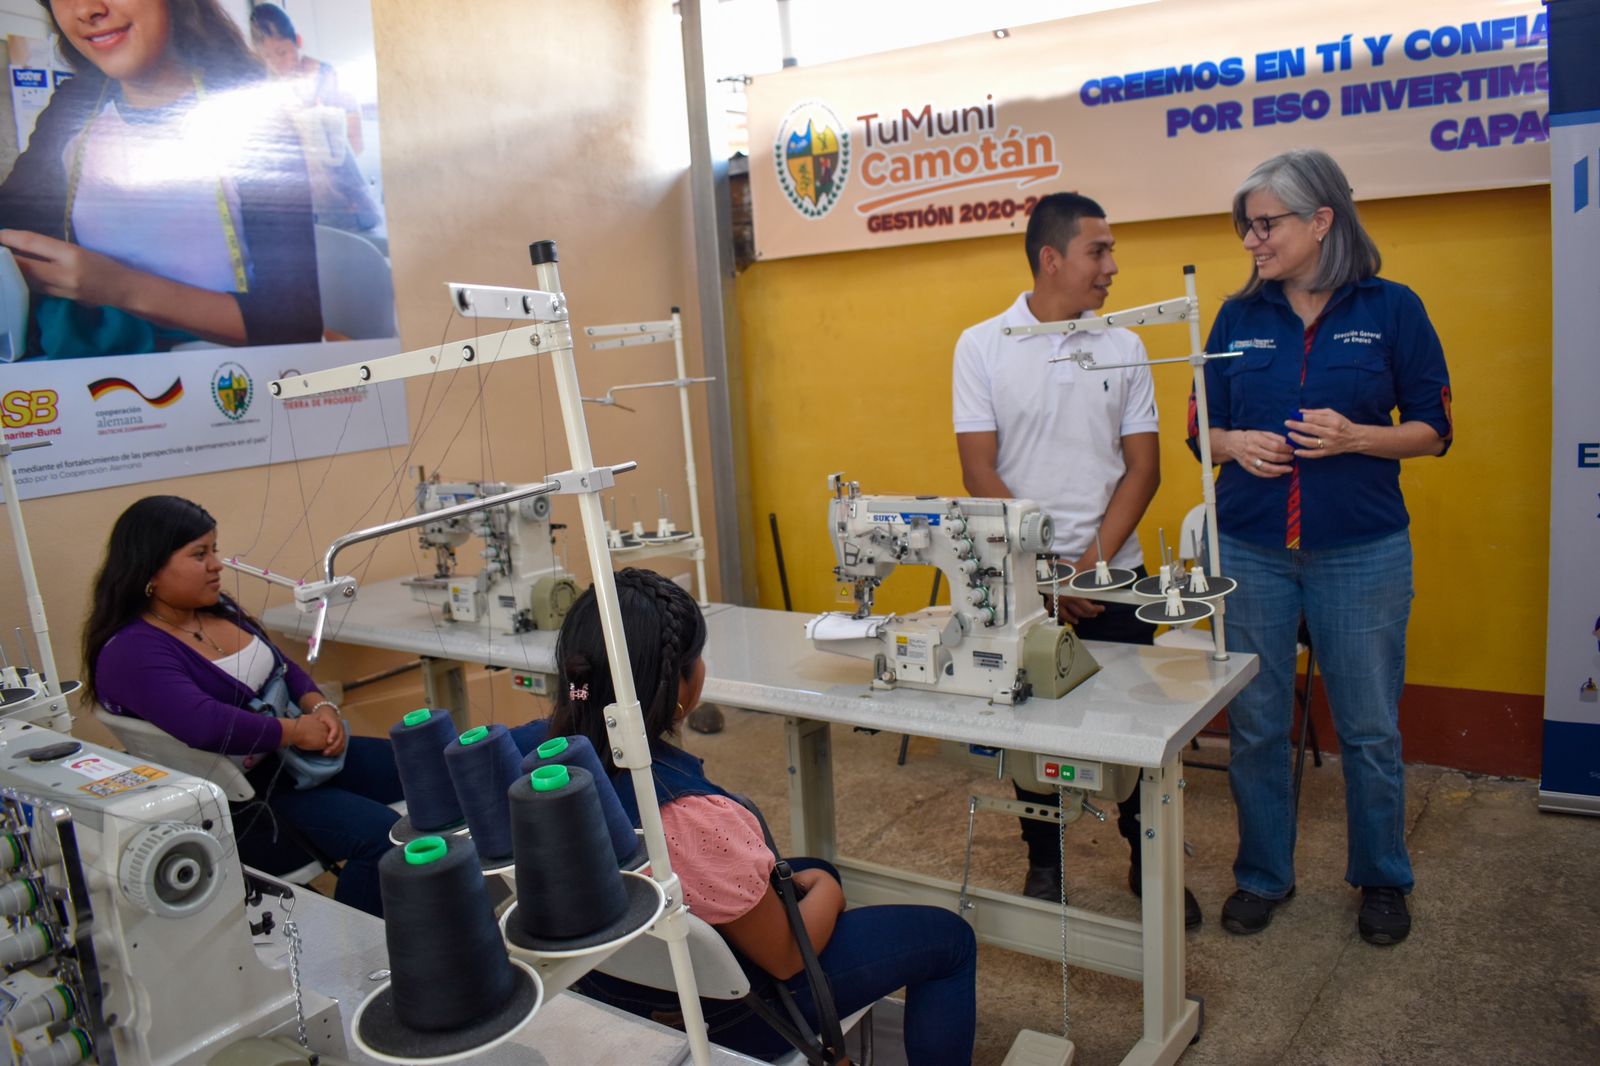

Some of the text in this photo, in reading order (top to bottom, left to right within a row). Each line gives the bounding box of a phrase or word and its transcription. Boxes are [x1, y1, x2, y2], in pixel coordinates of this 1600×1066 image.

[1079, 57, 1245, 107] CREEMOS
[1255, 47, 1305, 83] EN
[1316, 34, 1353, 74] TÍ
[1363, 34, 1392, 67] Y
[857, 94, 995, 147] TuMuni
[1166, 101, 1243, 138] POR
[1252, 89, 1330, 127] ESO
[1430, 110, 1549, 152] CAPA
[860, 128, 1053, 187] Camotán
[867, 203, 953, 233] GESTIÓN
[0, 389, 59, 429] SB
[97, 415, 143, 428] alemana
[18, 463, 55, 474] mediante
[56, 461, 63, 470] el
[64, 455, 120, 469] fortalecimiento
[121, 452, 130, 460] de
[131, 450, 141, 459] las
[142, 446, 184, 459] perspectivas
[185, 444, 194, 453] de
[873, 514, 897, 522] SUKY
